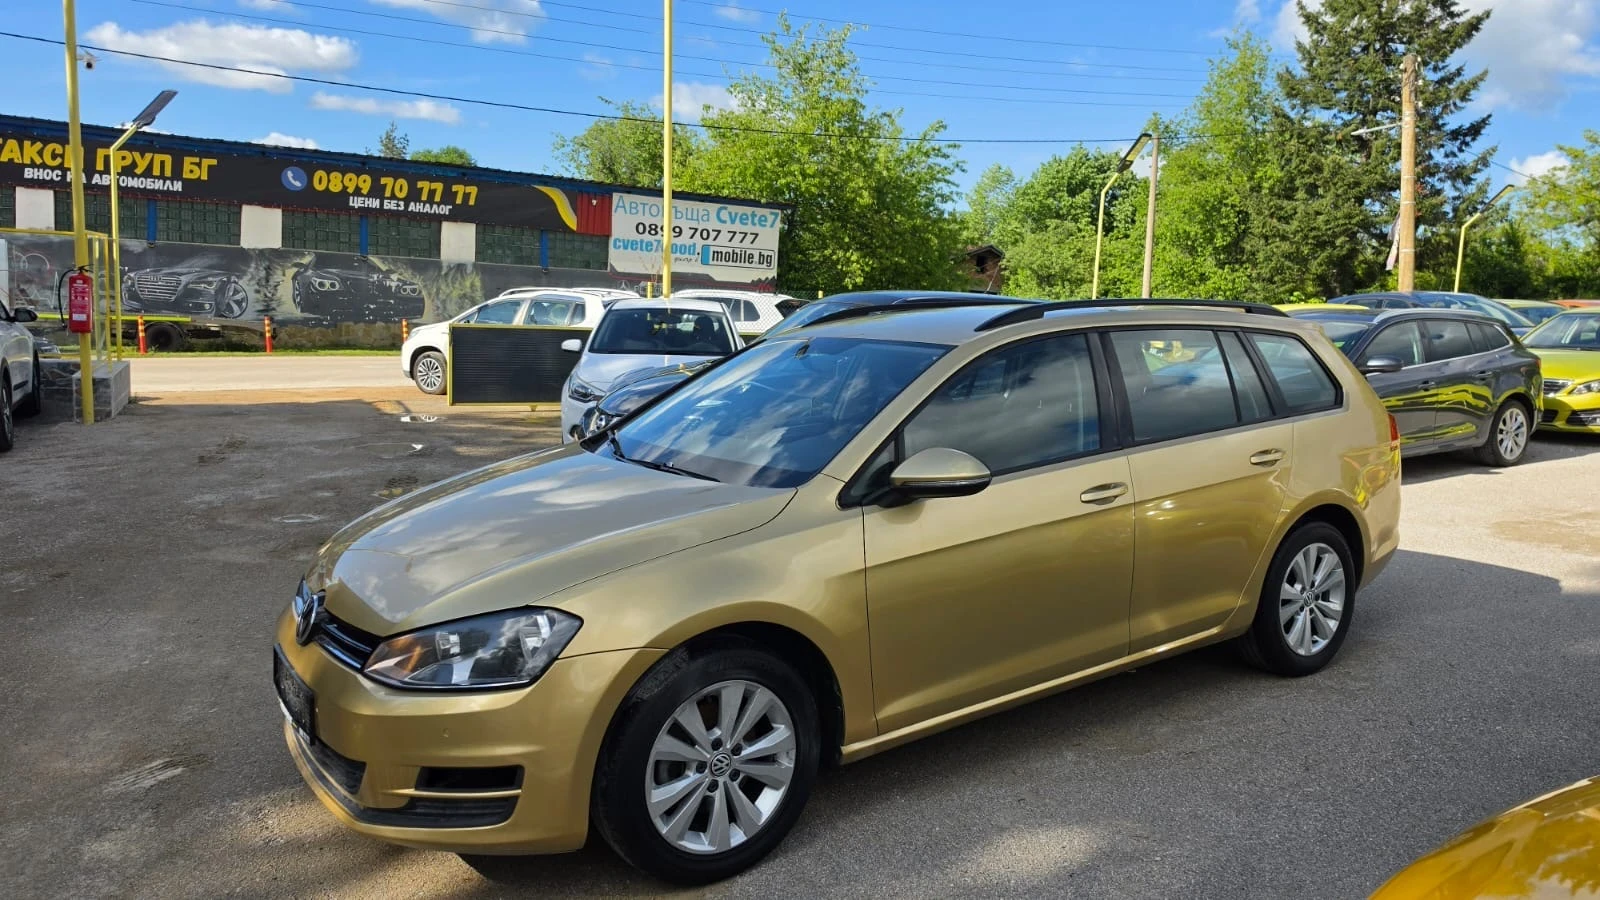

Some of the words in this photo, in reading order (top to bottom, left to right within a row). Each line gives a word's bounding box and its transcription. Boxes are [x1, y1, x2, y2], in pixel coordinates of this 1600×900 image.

[0, 137, 84, 169] АКС
[96, 148, 172, 177] ГРУП
[183, 156, 218, 181] БГ
[24, 168, 62, 181] ВНОС
[92, 173, 182, 191] АВОМОБИЛИ
[312, 169, 372, 195] 0899
[380, 177, 409, 199] 70
[416, 180, 444, 203] 77
[452, 184, 478, 206] 77
[349, 196, 380, 209] ЦЕНИ
[383, 199, 405, 211] БЕЗ
[408, 203, 453, 215] АНАЛОГ
[614, 195, 710, 224] Автоъща
[716, 206, 780, 228] Cvete7
[689, 227, 722, 241] 707
[728, 231, 759, 244] 777
[612, 238, 700, 256] cvete7ood.
[712, 249, 773, 267] mobile.bg
